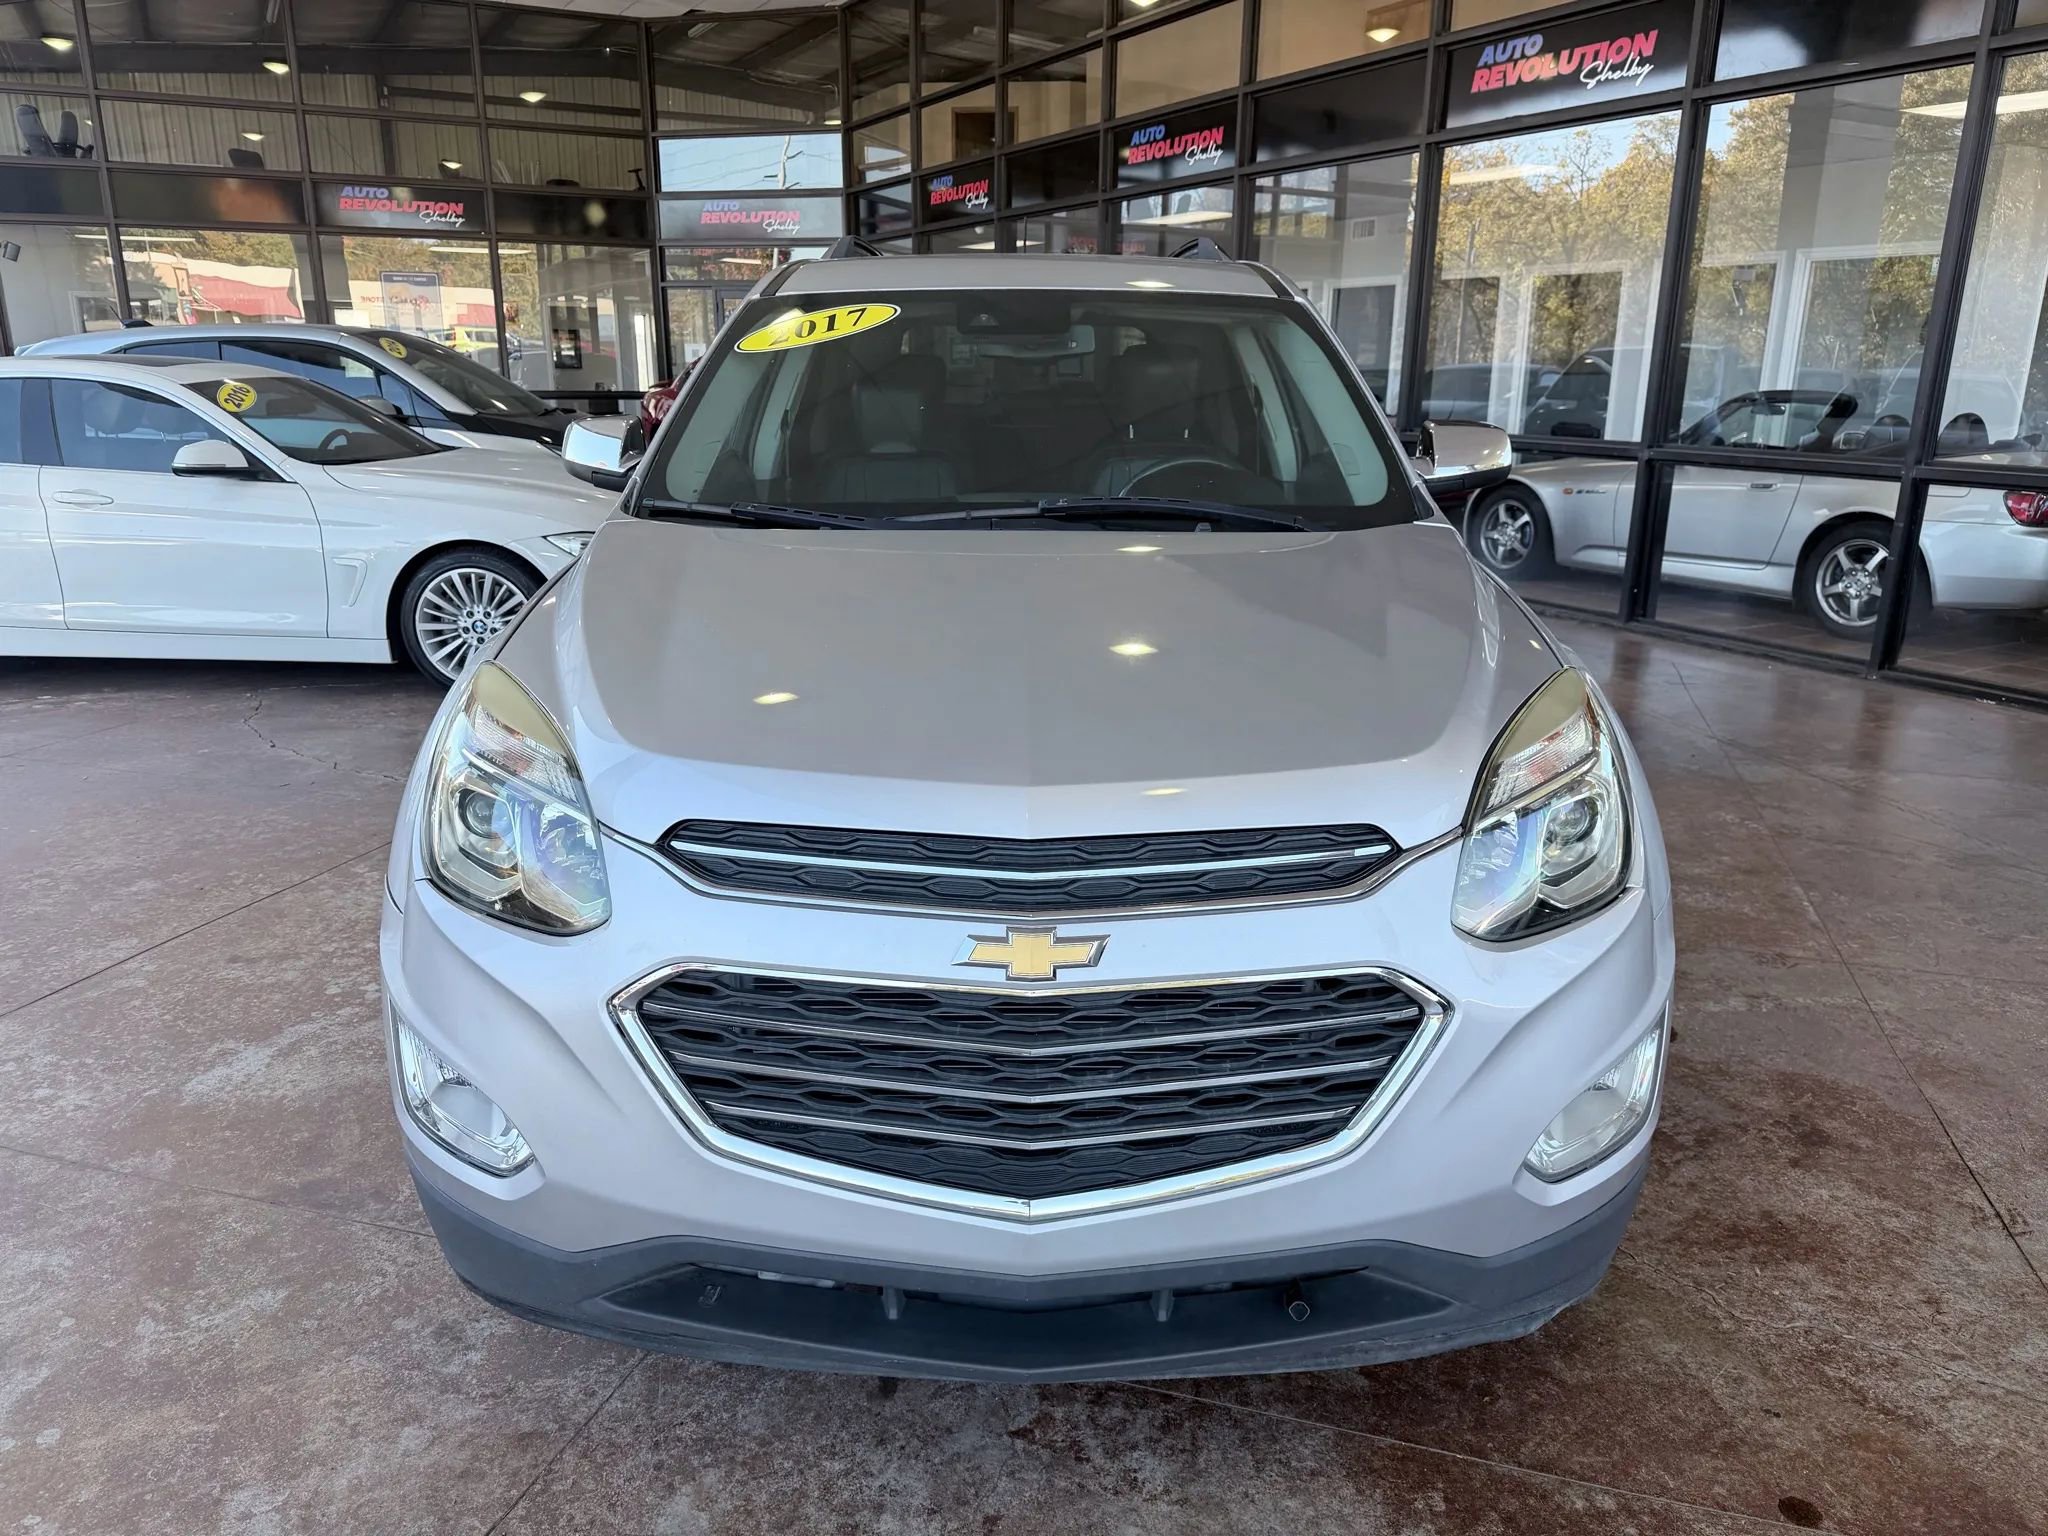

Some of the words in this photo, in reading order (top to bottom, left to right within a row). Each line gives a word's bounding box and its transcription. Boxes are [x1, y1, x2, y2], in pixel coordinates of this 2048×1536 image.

[1478, 33, 1543, 66] AUTO
[1471, 29, 1659, 93] REVOLUTION
[1580, 52, 1654, 89] Shelby
[1128, 126, 1224, 164] REVOLUTION
[1131, 124, 1165, 145] AUTO
[1185, 140, 1223, 165] Shelby
[341, 186, 389, 198] AUTO
[930, 179, 989, 205] REVOLUTION
[932, 175, 953, 190] AUTO
[340, 198, 464, 214] REVOLUTION
[703, 201, 739, 211] AUTO
[419, 209, 465, 227] Shelby
[700, 211, 800, 224] REVOLUTION
[763, 219, 800, 235] Shelby
[768, 307, 867, 347] 2017
[224, 385, 250, 408] 2016
